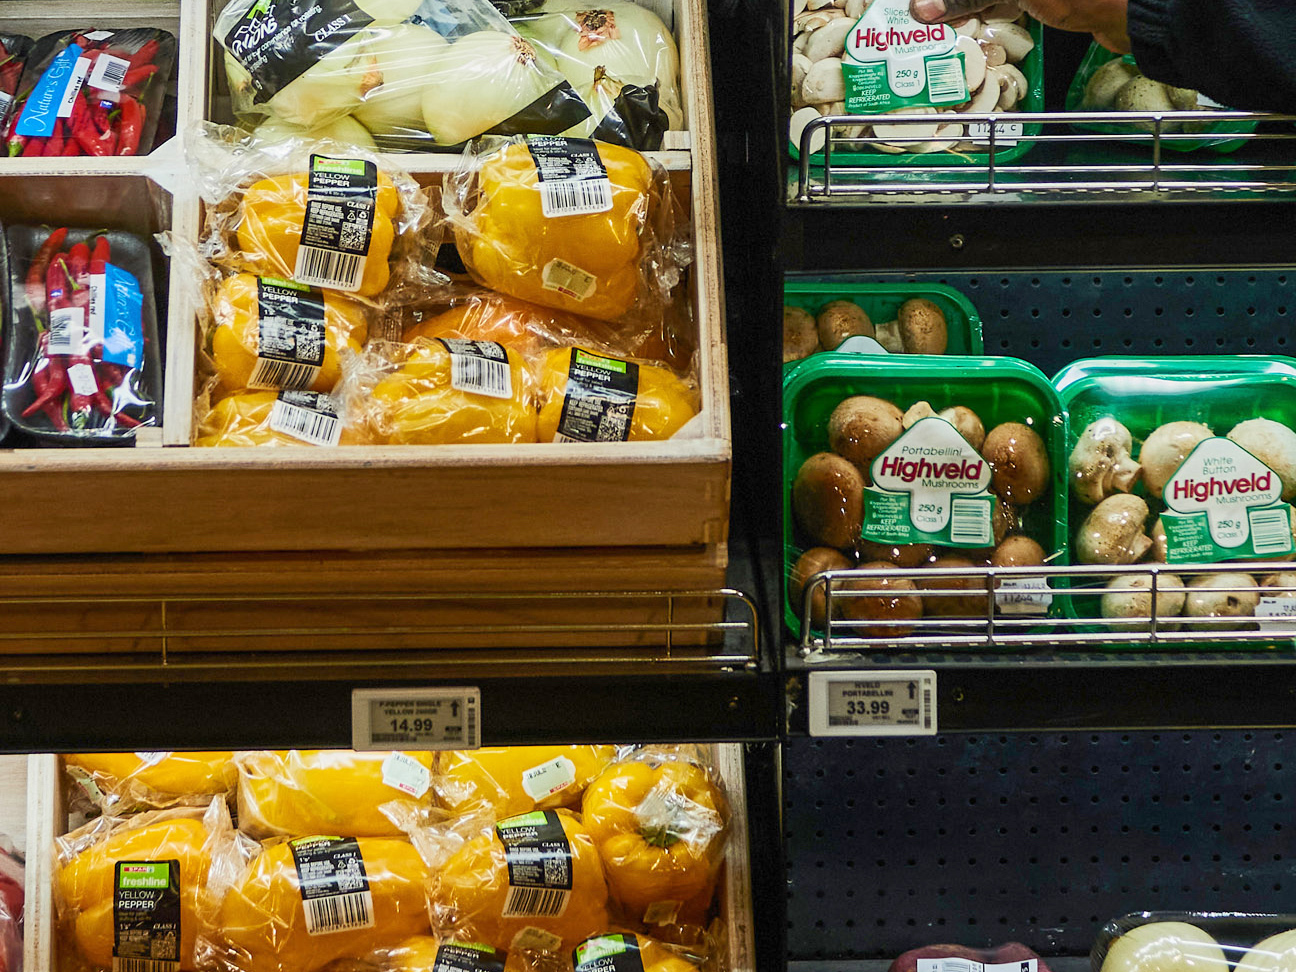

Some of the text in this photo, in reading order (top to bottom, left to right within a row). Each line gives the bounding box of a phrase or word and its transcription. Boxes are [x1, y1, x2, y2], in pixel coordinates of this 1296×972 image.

[886, 16, 909, 25] White
[314, 17, 346, 42] CLASS
[856, 23, 945, 52] Highveld
[896, 70, 912, 79] 250
[895, 80, 916, 89] Class
[24, 57, 71, 132] Nature's Gift
[862, 89, 876, 97] KEEP
[849, 94, 890, 103] REFRIGERATED
[313, 172, 350, 180] YELLOW
[313, 178, 350, 187] PEPPER
[347, 201, 365, 210] CLASS
[262, 286, 297, 296] YELLOW
[263, 292, 298, 304] PEPPER
[576, 364, 611, 375] YELLOW
[574, 369, 611, 381] PEPPER
[902, 445, 962, 456] Portabellini
[1204, 456, 1233, 467] White
[880, 457, 983, 483] Highveld
[1203, 465, 1236, 476] Button
[922, 479, 979, 489] Mushrooms
[1174, 472, 1271, 502] Highveld
[1216, 493, 1272, 504] Mushrooms
[918, 504, 935, 512] 250
[916, 514, 938, 523] Class
[1217, 520, 1234, 528] 250
[847, 701, 889, 715] 33.99
[391, 719, 433, 732] 14.99
[502, 827, 535, 836] YELLOW
[503, 831, 538, 839] PEPPER
[123, 877, 166, 887] freshline
[119, 891, 155, 899] YELLOW
[119, 900, 155, 908] PEPPER
[580, 957, 613, 971] YELLOW
